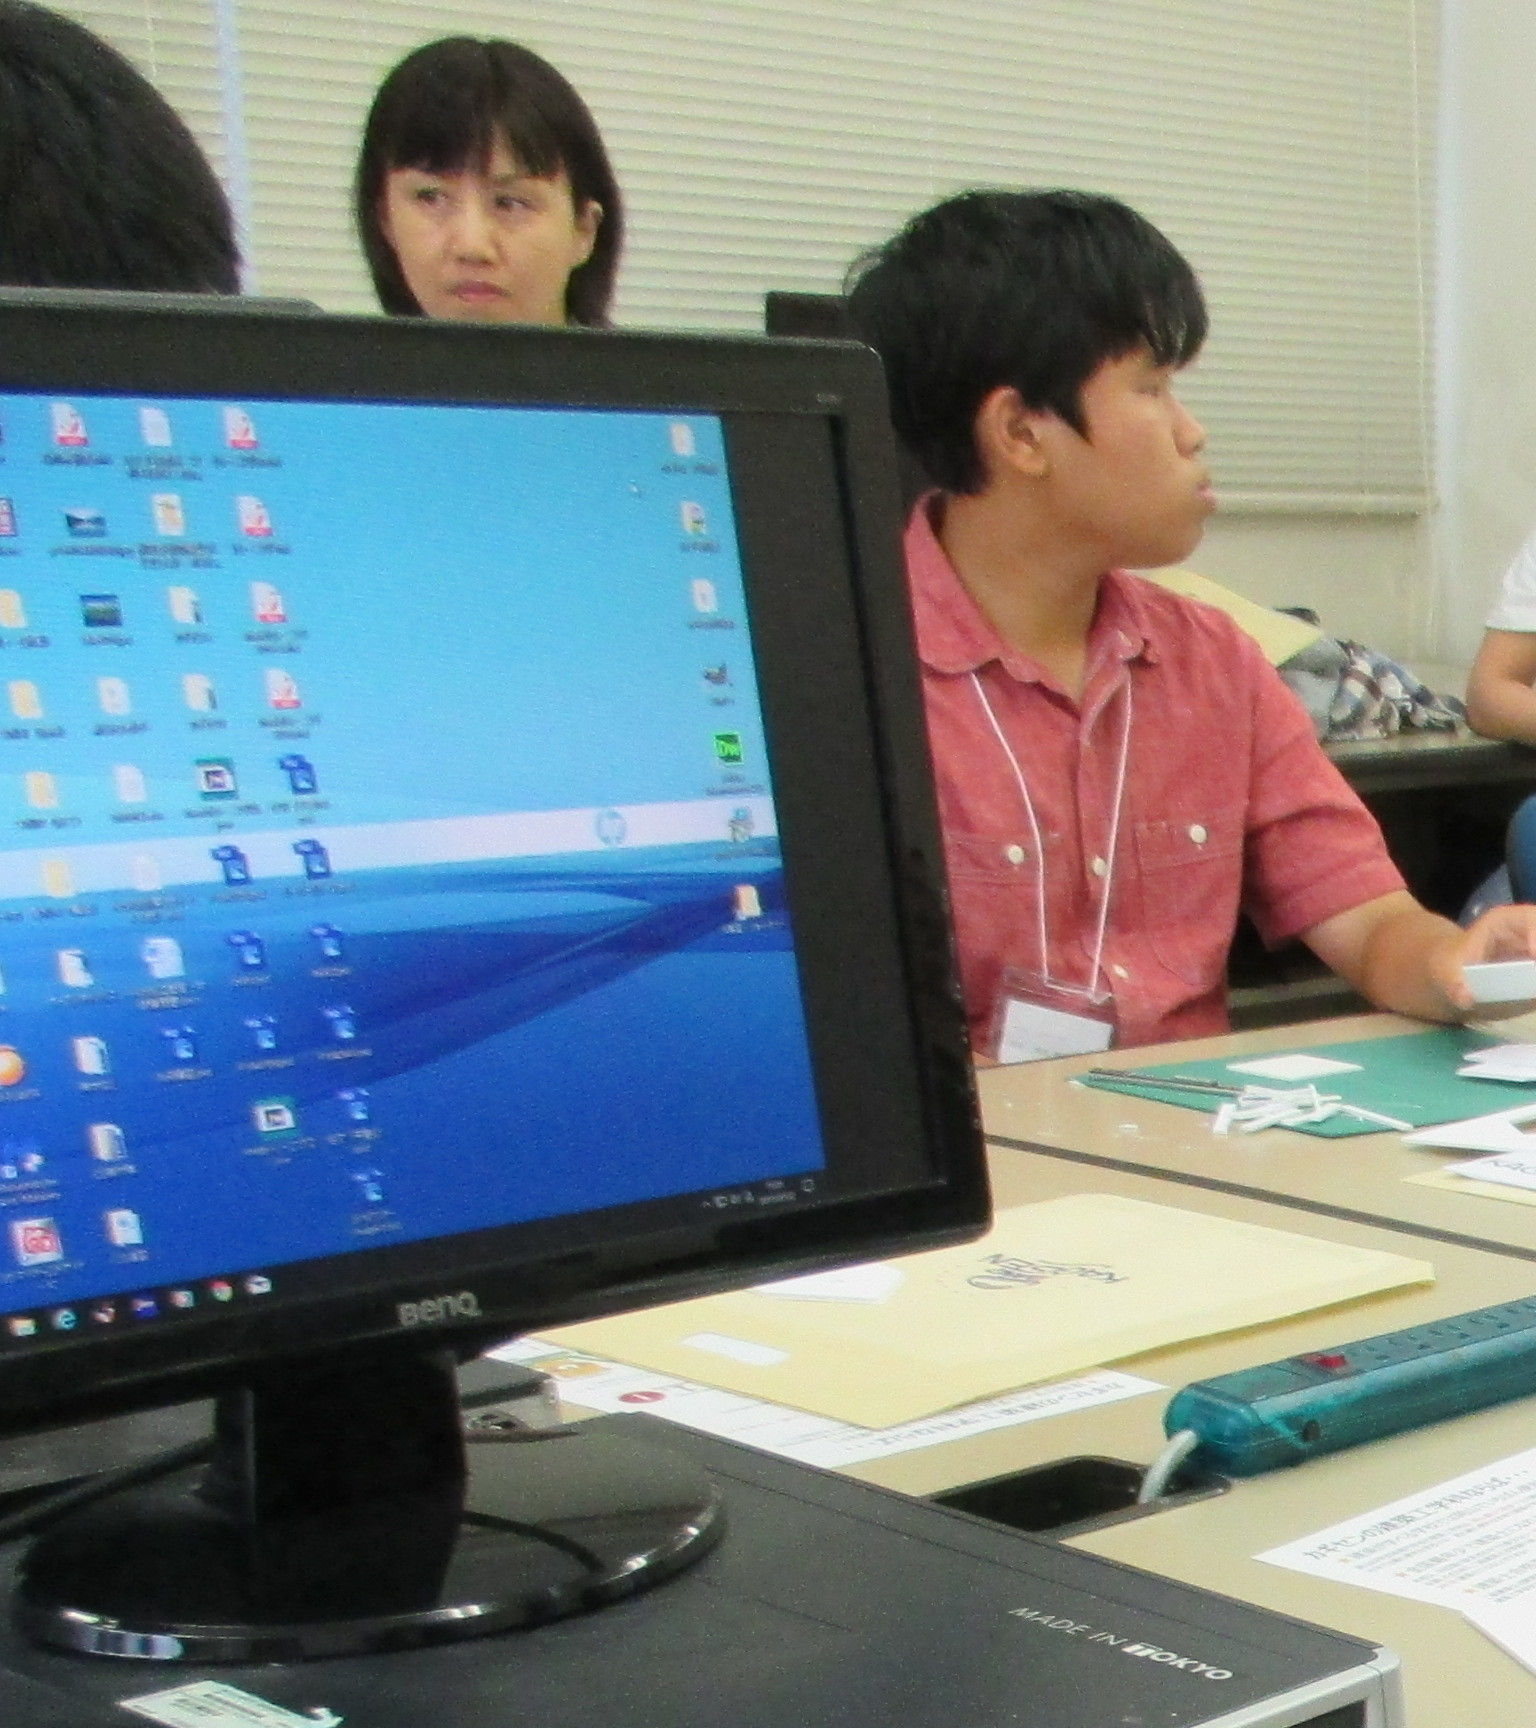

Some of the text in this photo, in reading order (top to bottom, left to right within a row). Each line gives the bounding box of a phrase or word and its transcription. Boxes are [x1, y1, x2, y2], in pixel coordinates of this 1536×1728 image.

[1008, 1607, 1234, 1681] MADE IN TOKYO
